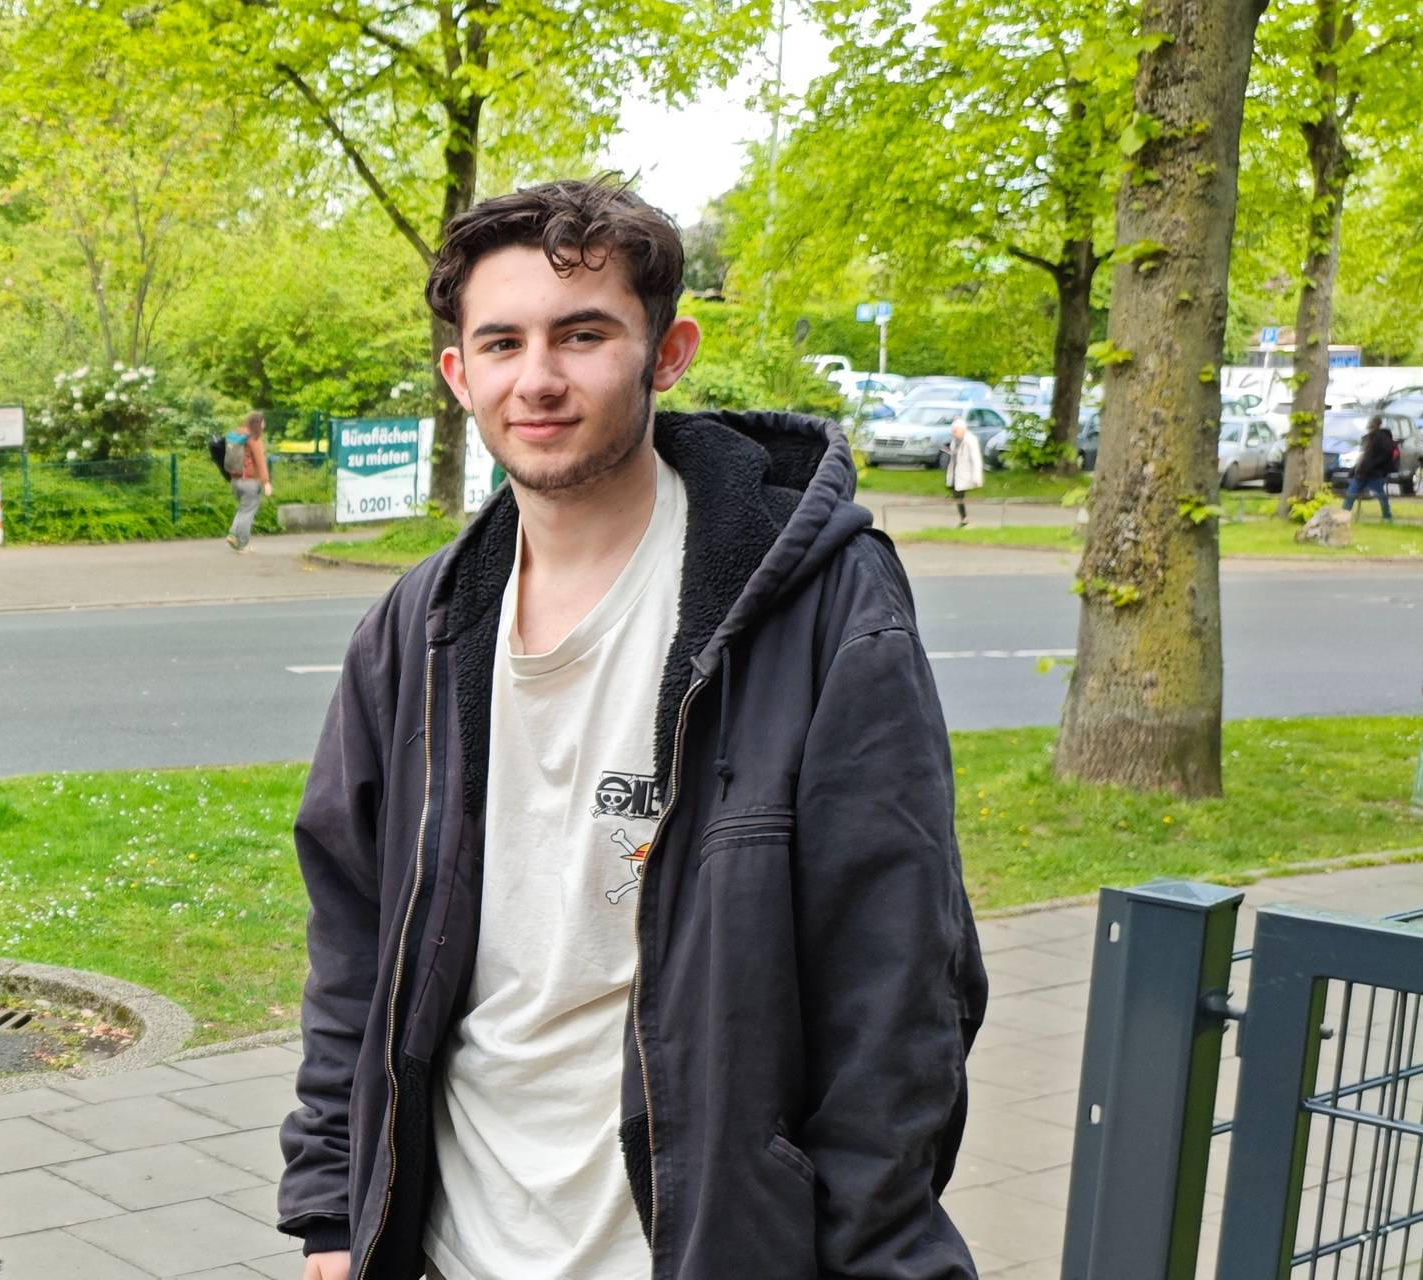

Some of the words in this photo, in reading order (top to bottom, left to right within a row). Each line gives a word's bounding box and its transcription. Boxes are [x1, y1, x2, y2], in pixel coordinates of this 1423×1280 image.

[341, 426, 417, 447] Büroflächen
[348, 454, 363, 467] zu
[366, 447, 409, 466] mieten
[359, 496, 392, 513] 0201
